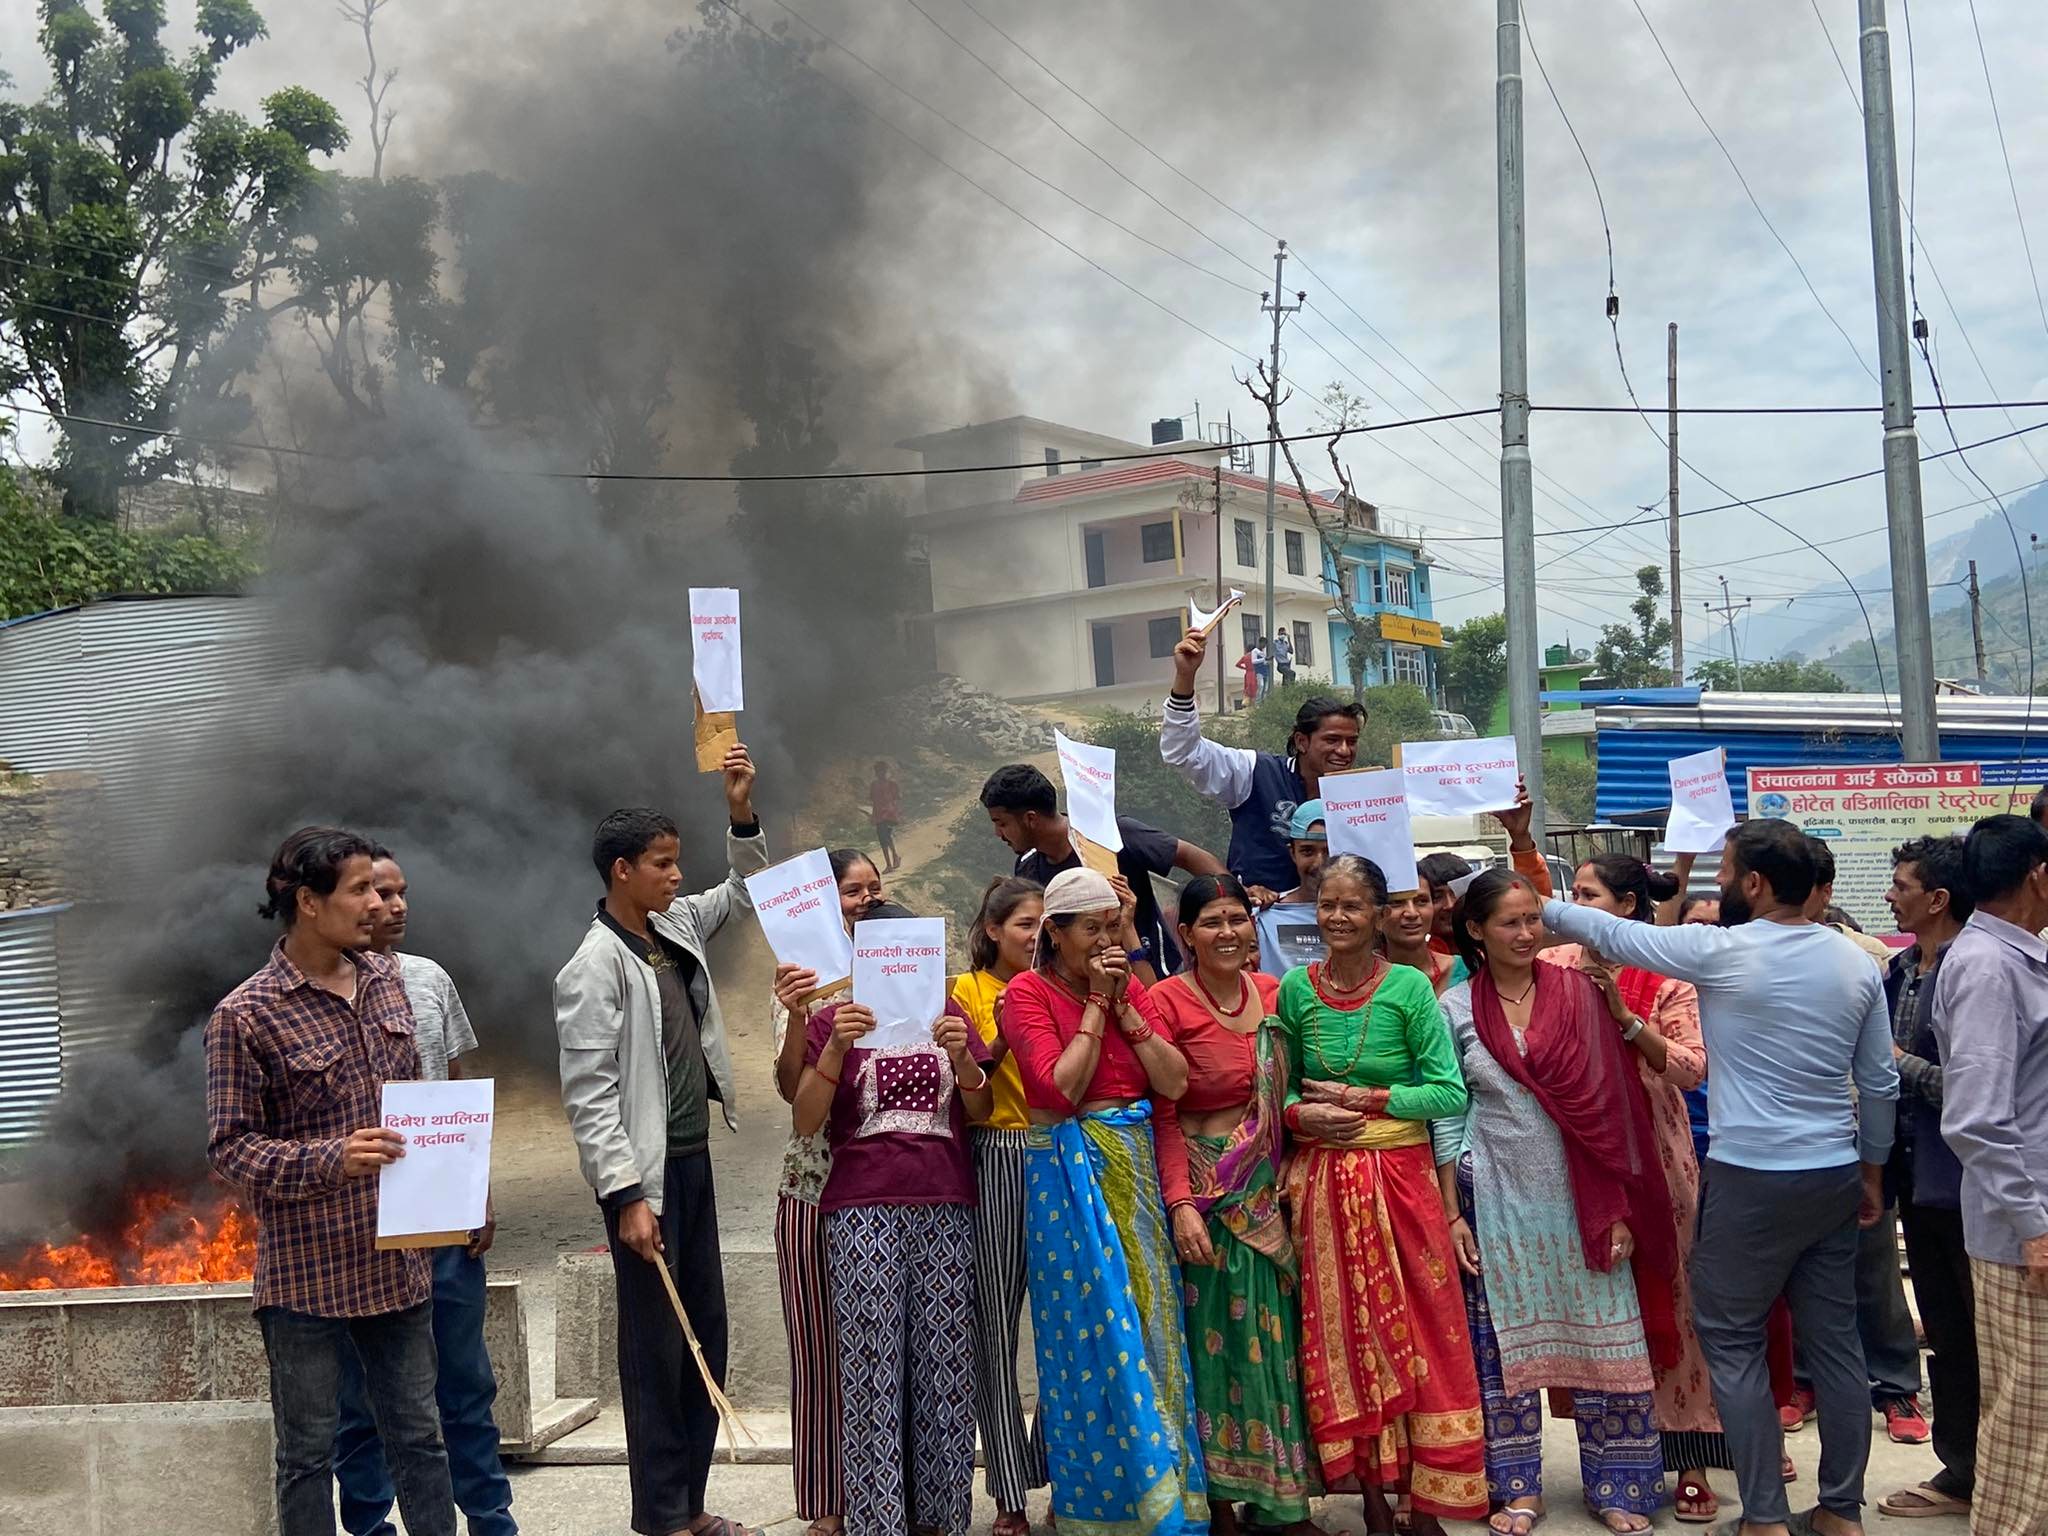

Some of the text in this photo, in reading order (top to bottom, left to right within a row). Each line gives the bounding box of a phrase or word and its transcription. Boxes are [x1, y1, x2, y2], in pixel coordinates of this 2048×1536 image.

[1406, 763, 1461, 774] सरकारको
[1757, 773, 1837, 788] संचालनमा
[1843, 769, 1877, 787] आई
[1883, 768, 1939, 785] सकेको
[1945, 770, 1963, 783] छ
[1326, 795, 1404, 811] जिल्ला प्रशासन
[1792, 794, 1835, 813] होटेल
[1842, 791, 1930, 811] बडिमालिका
[802, 875, 833, 893] सरकार
[906, 947, 941, 957] सरकार
[385, 1111, 489, 1128] दिनेश थपलिया
